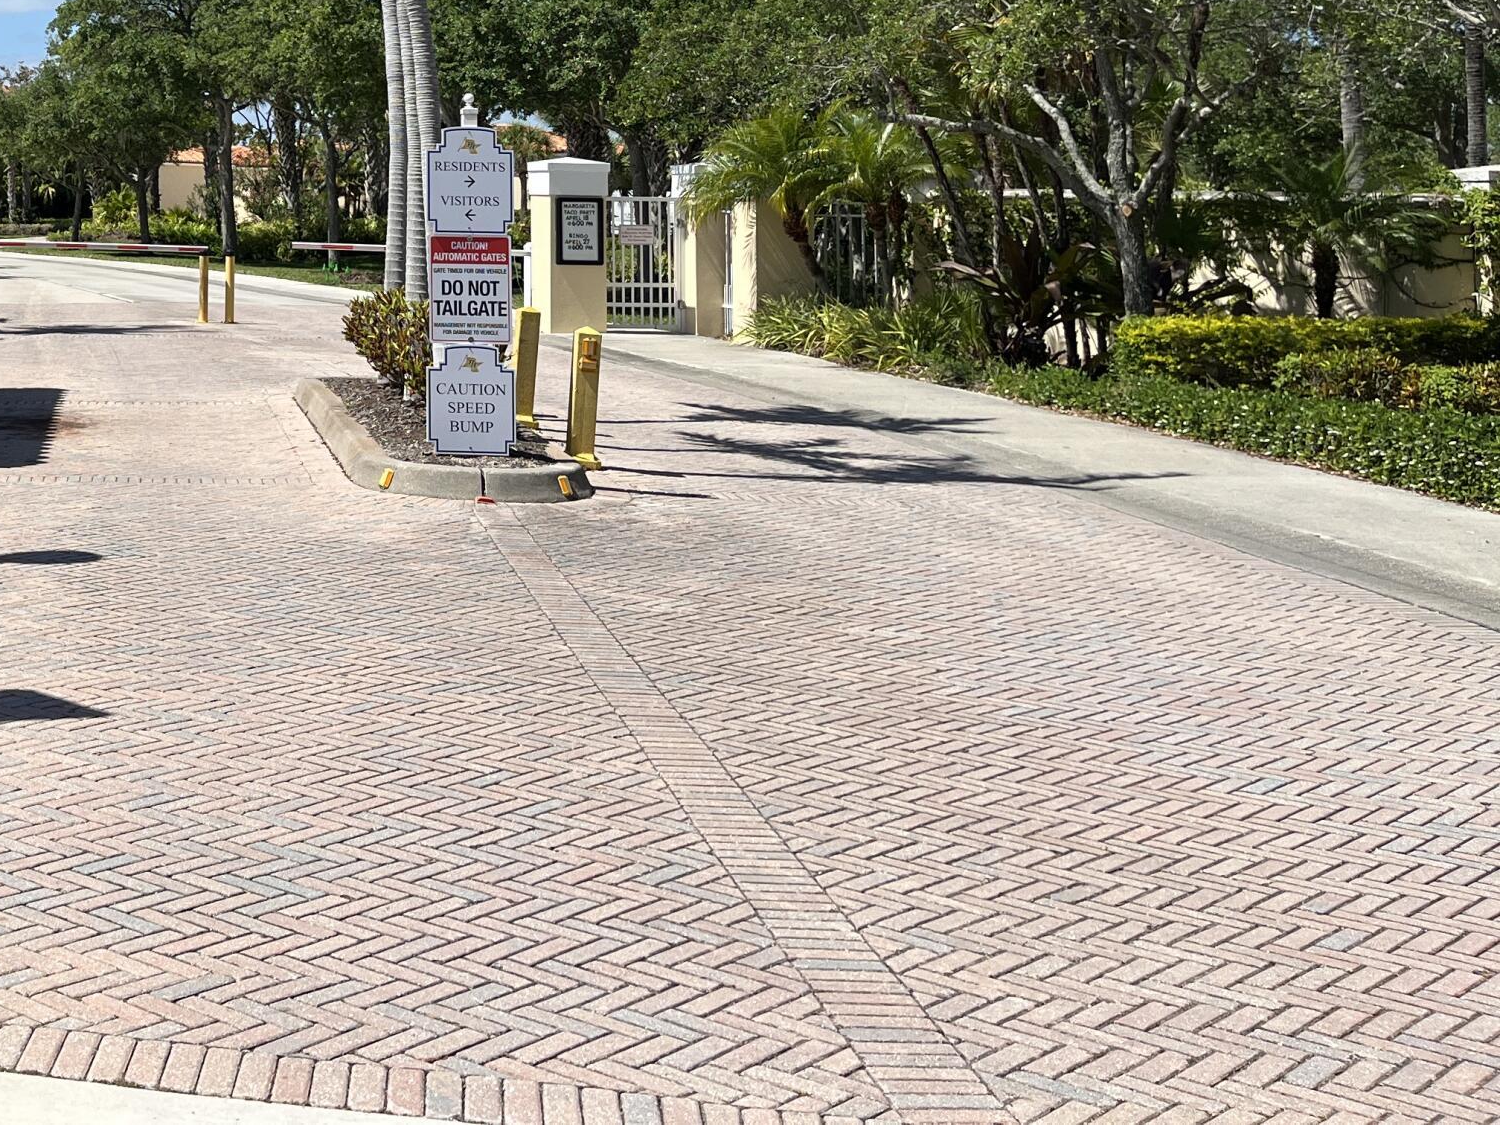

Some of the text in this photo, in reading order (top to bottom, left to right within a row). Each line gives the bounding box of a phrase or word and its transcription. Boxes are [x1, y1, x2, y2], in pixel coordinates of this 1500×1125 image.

[434, 161, 506, 173] RESIDENTS
[441, 195, 500, 207] VISITORS
[451, 241, 488, 251] CAUTION!
[433, 252, 507, 263] AUTOMATIC GATES
[441, 279, 500, 297] DO NOT
[433, 299, 507, 317] TAILGATE
[436, 382, 506, 396] CAUTION
[447, 401, 496, 415] SPEED
[450, 420, 494, 434] BUMP
